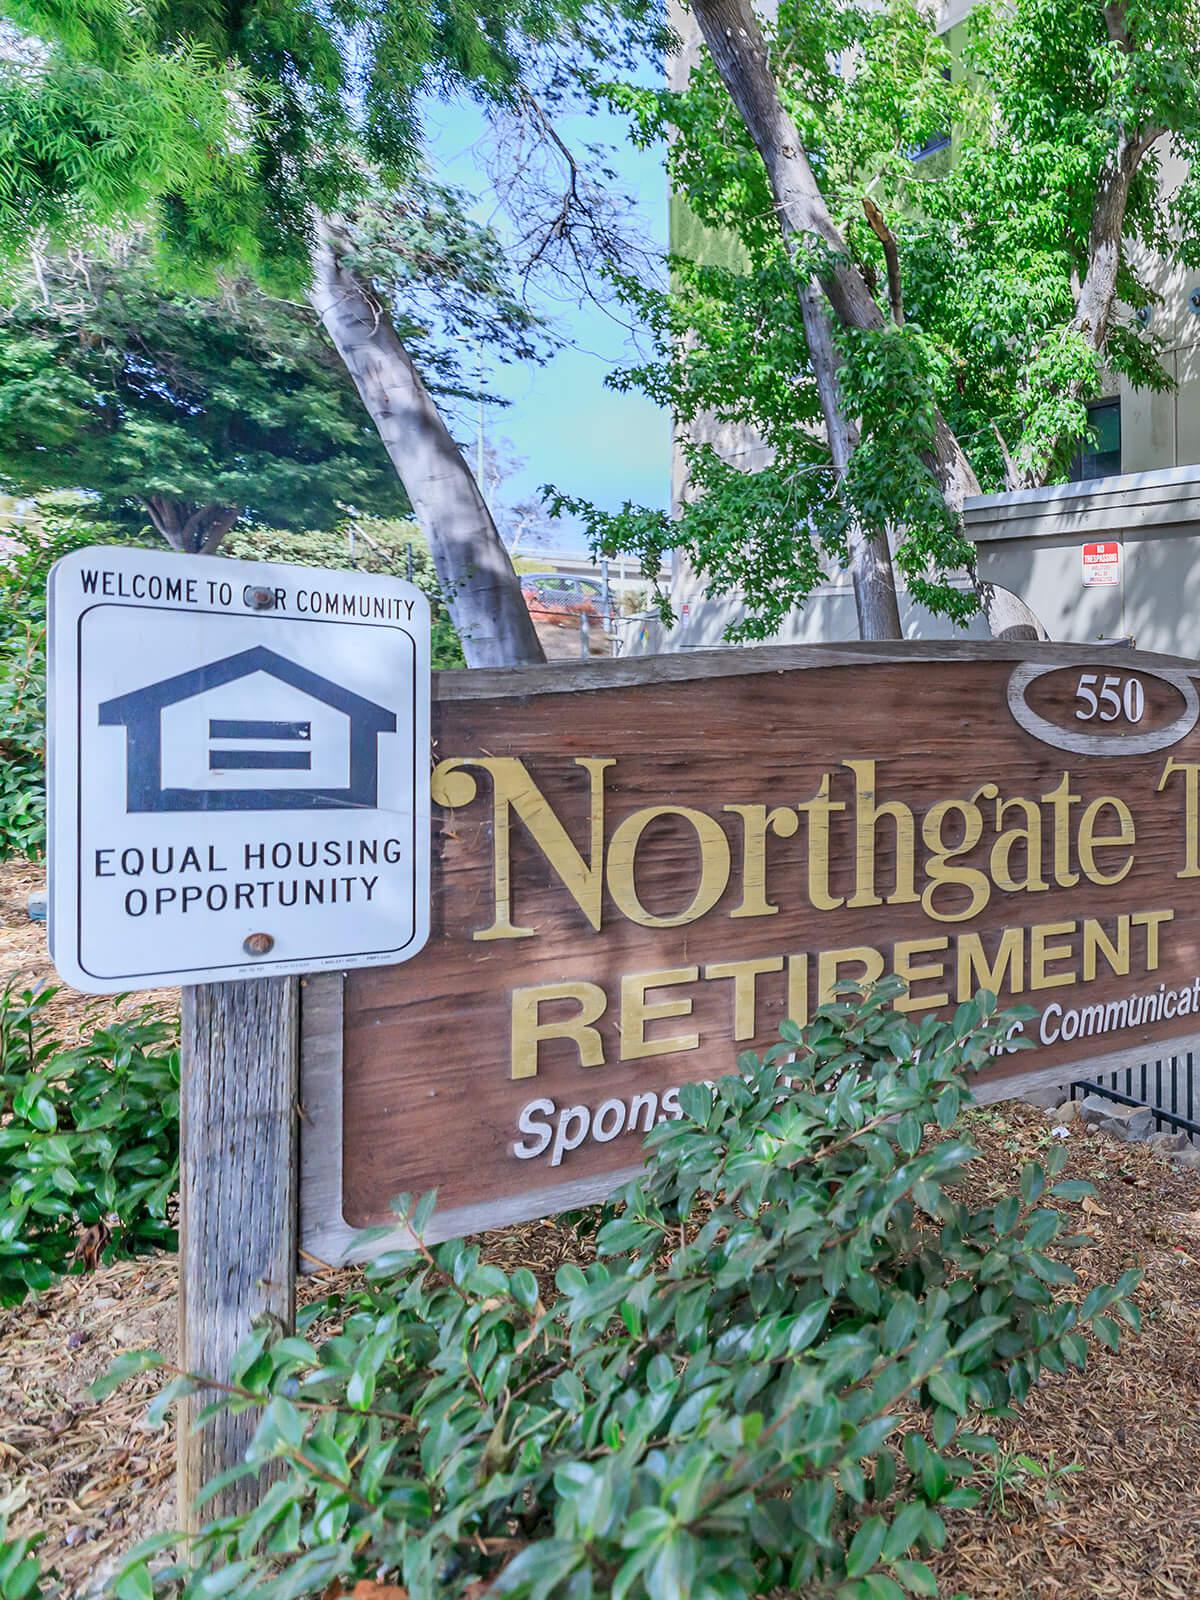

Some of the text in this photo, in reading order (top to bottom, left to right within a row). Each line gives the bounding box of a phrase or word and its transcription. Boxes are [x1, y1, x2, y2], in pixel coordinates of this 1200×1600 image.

[80, 568, 199, 604] WELCOME
[206, 581, 233, 606] TO
[296, 590, 416, 622] COMMUNITY
[1074, 673, 1145, 724] 550
[95, 838, 402, 879] EQUAL HOUSING
[431, 756, 1137, 941] Northgate
[125, 876, 380, 917] OPPORTUNITY
[510, 908, 1175, 1080] RETIREMENT
